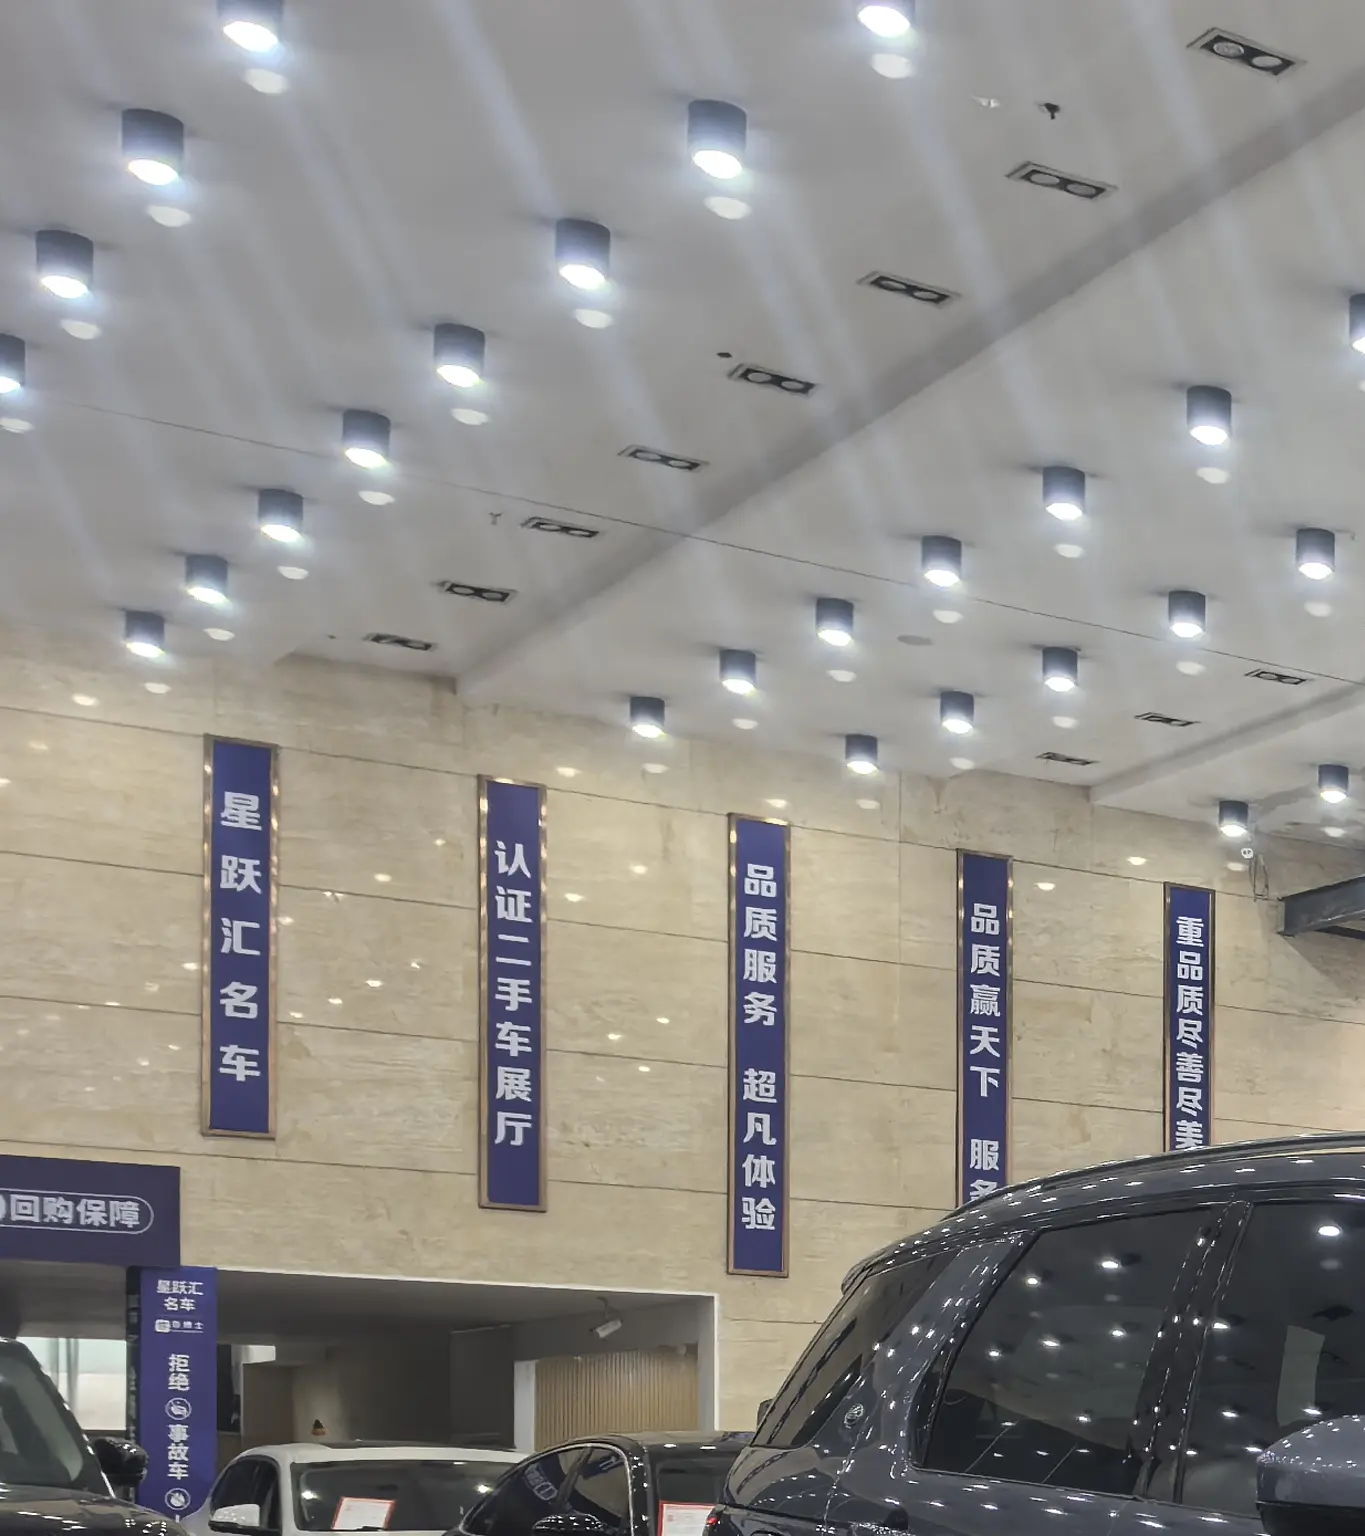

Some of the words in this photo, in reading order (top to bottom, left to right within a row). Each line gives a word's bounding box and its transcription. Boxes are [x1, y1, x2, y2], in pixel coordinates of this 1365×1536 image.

[220, 792, 262, 1083] 星跃汇名车
[494, 840, 533, 1148] 认证二手车展厅
[743, 863, 778, 1027] 品质服务
[968, 903, 1002, 1099] 品质赢天下
[1175, 915, 1205, 1151] 重品质尽善尽美
[10, 1193, 141, 1229] 回购保障
[741, 1068, 778, 1232] 超凡体验
[156, 1279, 204, 1296] 星跃汇
[163, 1296, 197, 1312] 名车
[166, 1423, 190, 1481] 事故车
[167, 1353, 191, 1392] 拒绝
